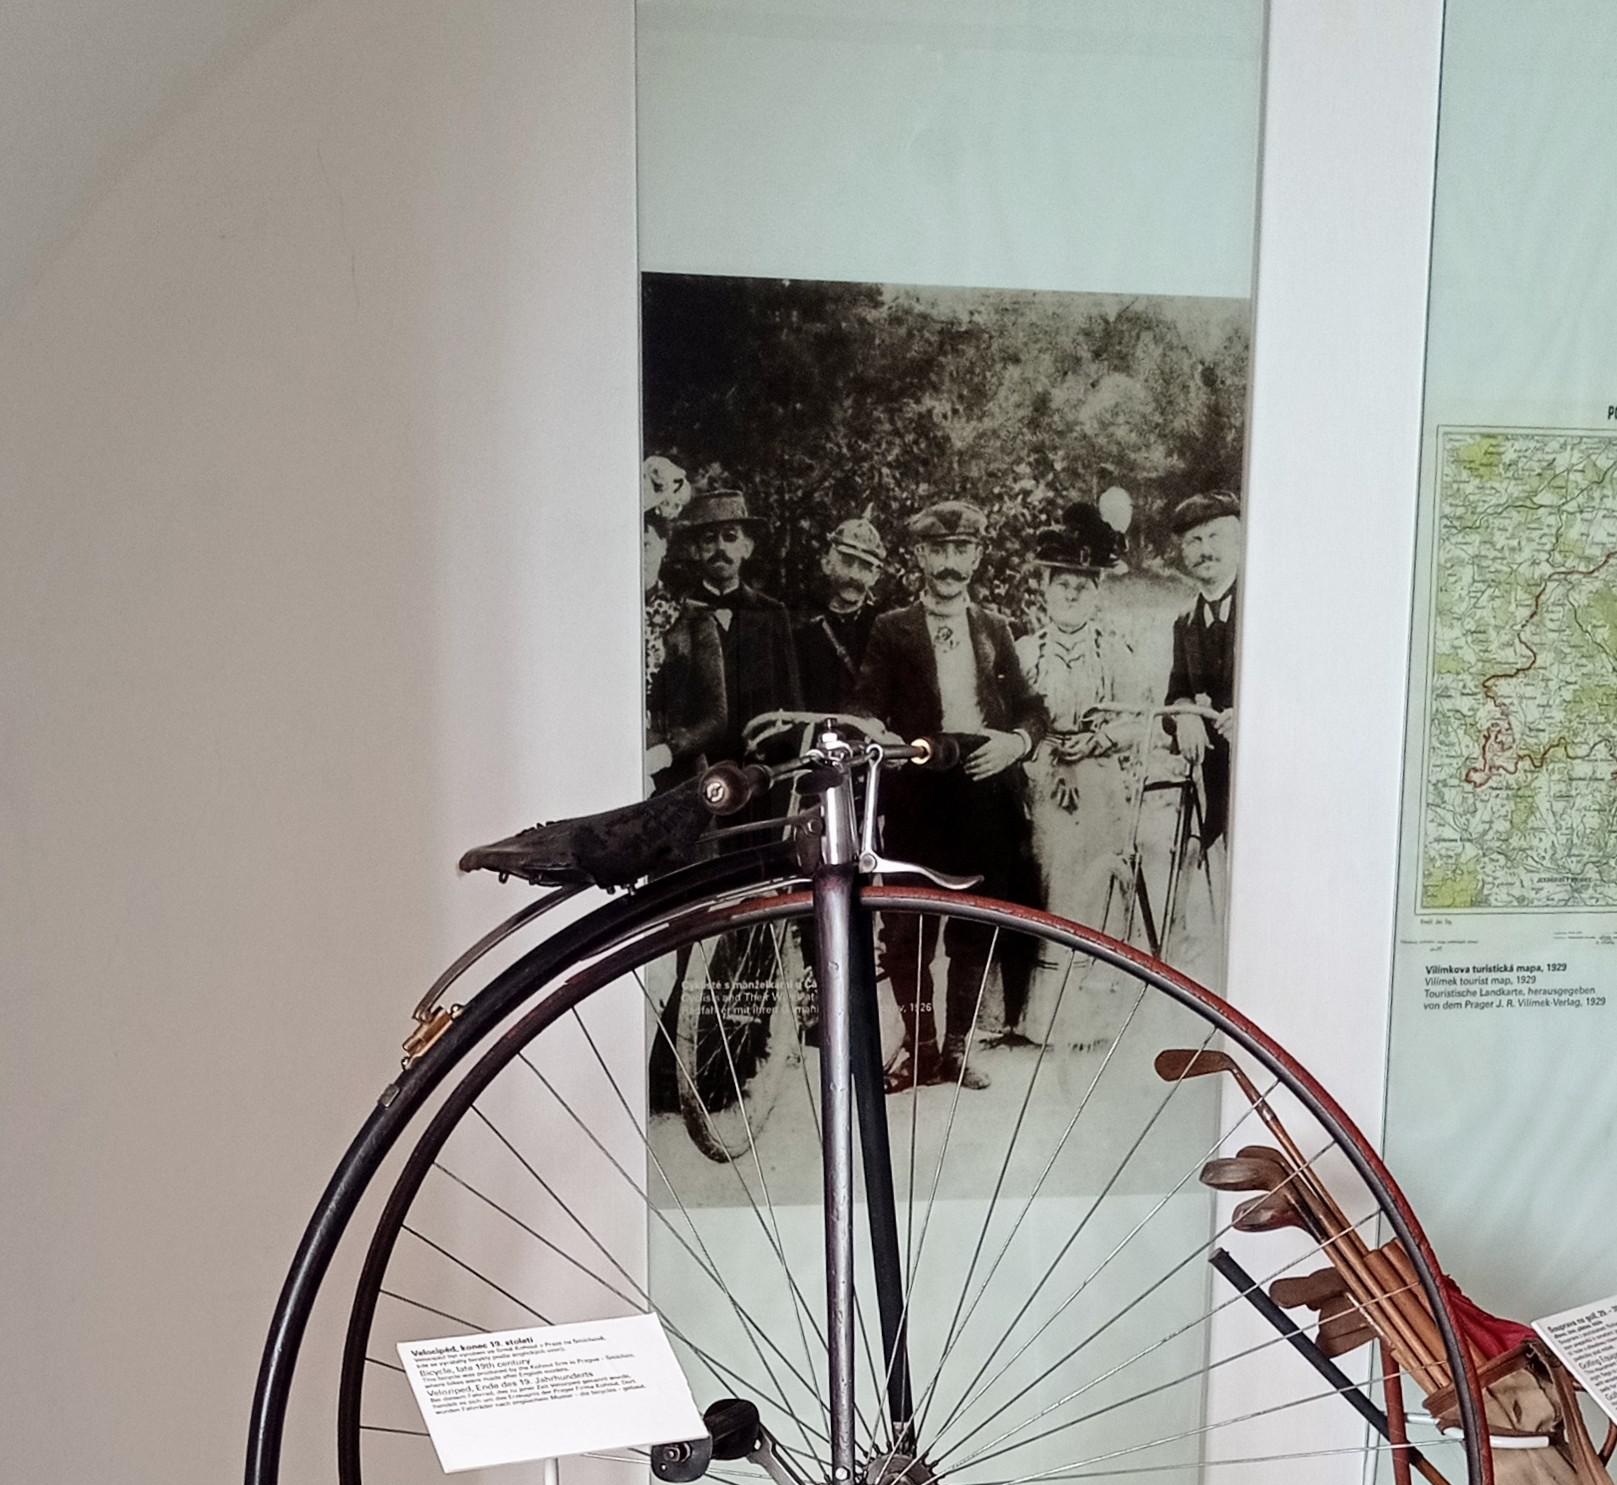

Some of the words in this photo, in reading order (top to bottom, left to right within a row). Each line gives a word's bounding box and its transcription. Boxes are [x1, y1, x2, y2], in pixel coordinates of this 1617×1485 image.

[1472, 963, 1514, 974] turistická
[1516, 965, 1544, 974] mapa,
[1546, 963, 1567, 973] 1929
[1459, 976, 1488, 986] tourist
[1490, 976, 1514, 986] map,
[1516, 975, 1537, 985] 1929
[1424, 988, 1478, 998] Touristische
[1479, 987, 1526, 998] Landkarte,
[1527, 986, 1596, 997] herausgegeben
[1423, 1001, 1440, 1010] von
[1442, 1000, 1463, 1010] dem
[1465, 999, 1494, 1010] Prager
[1495, 999, 1504, 1009] J.
[1506, 998, 1515, 1008] R.
[1586, 996, 1606, 1007] 1929
